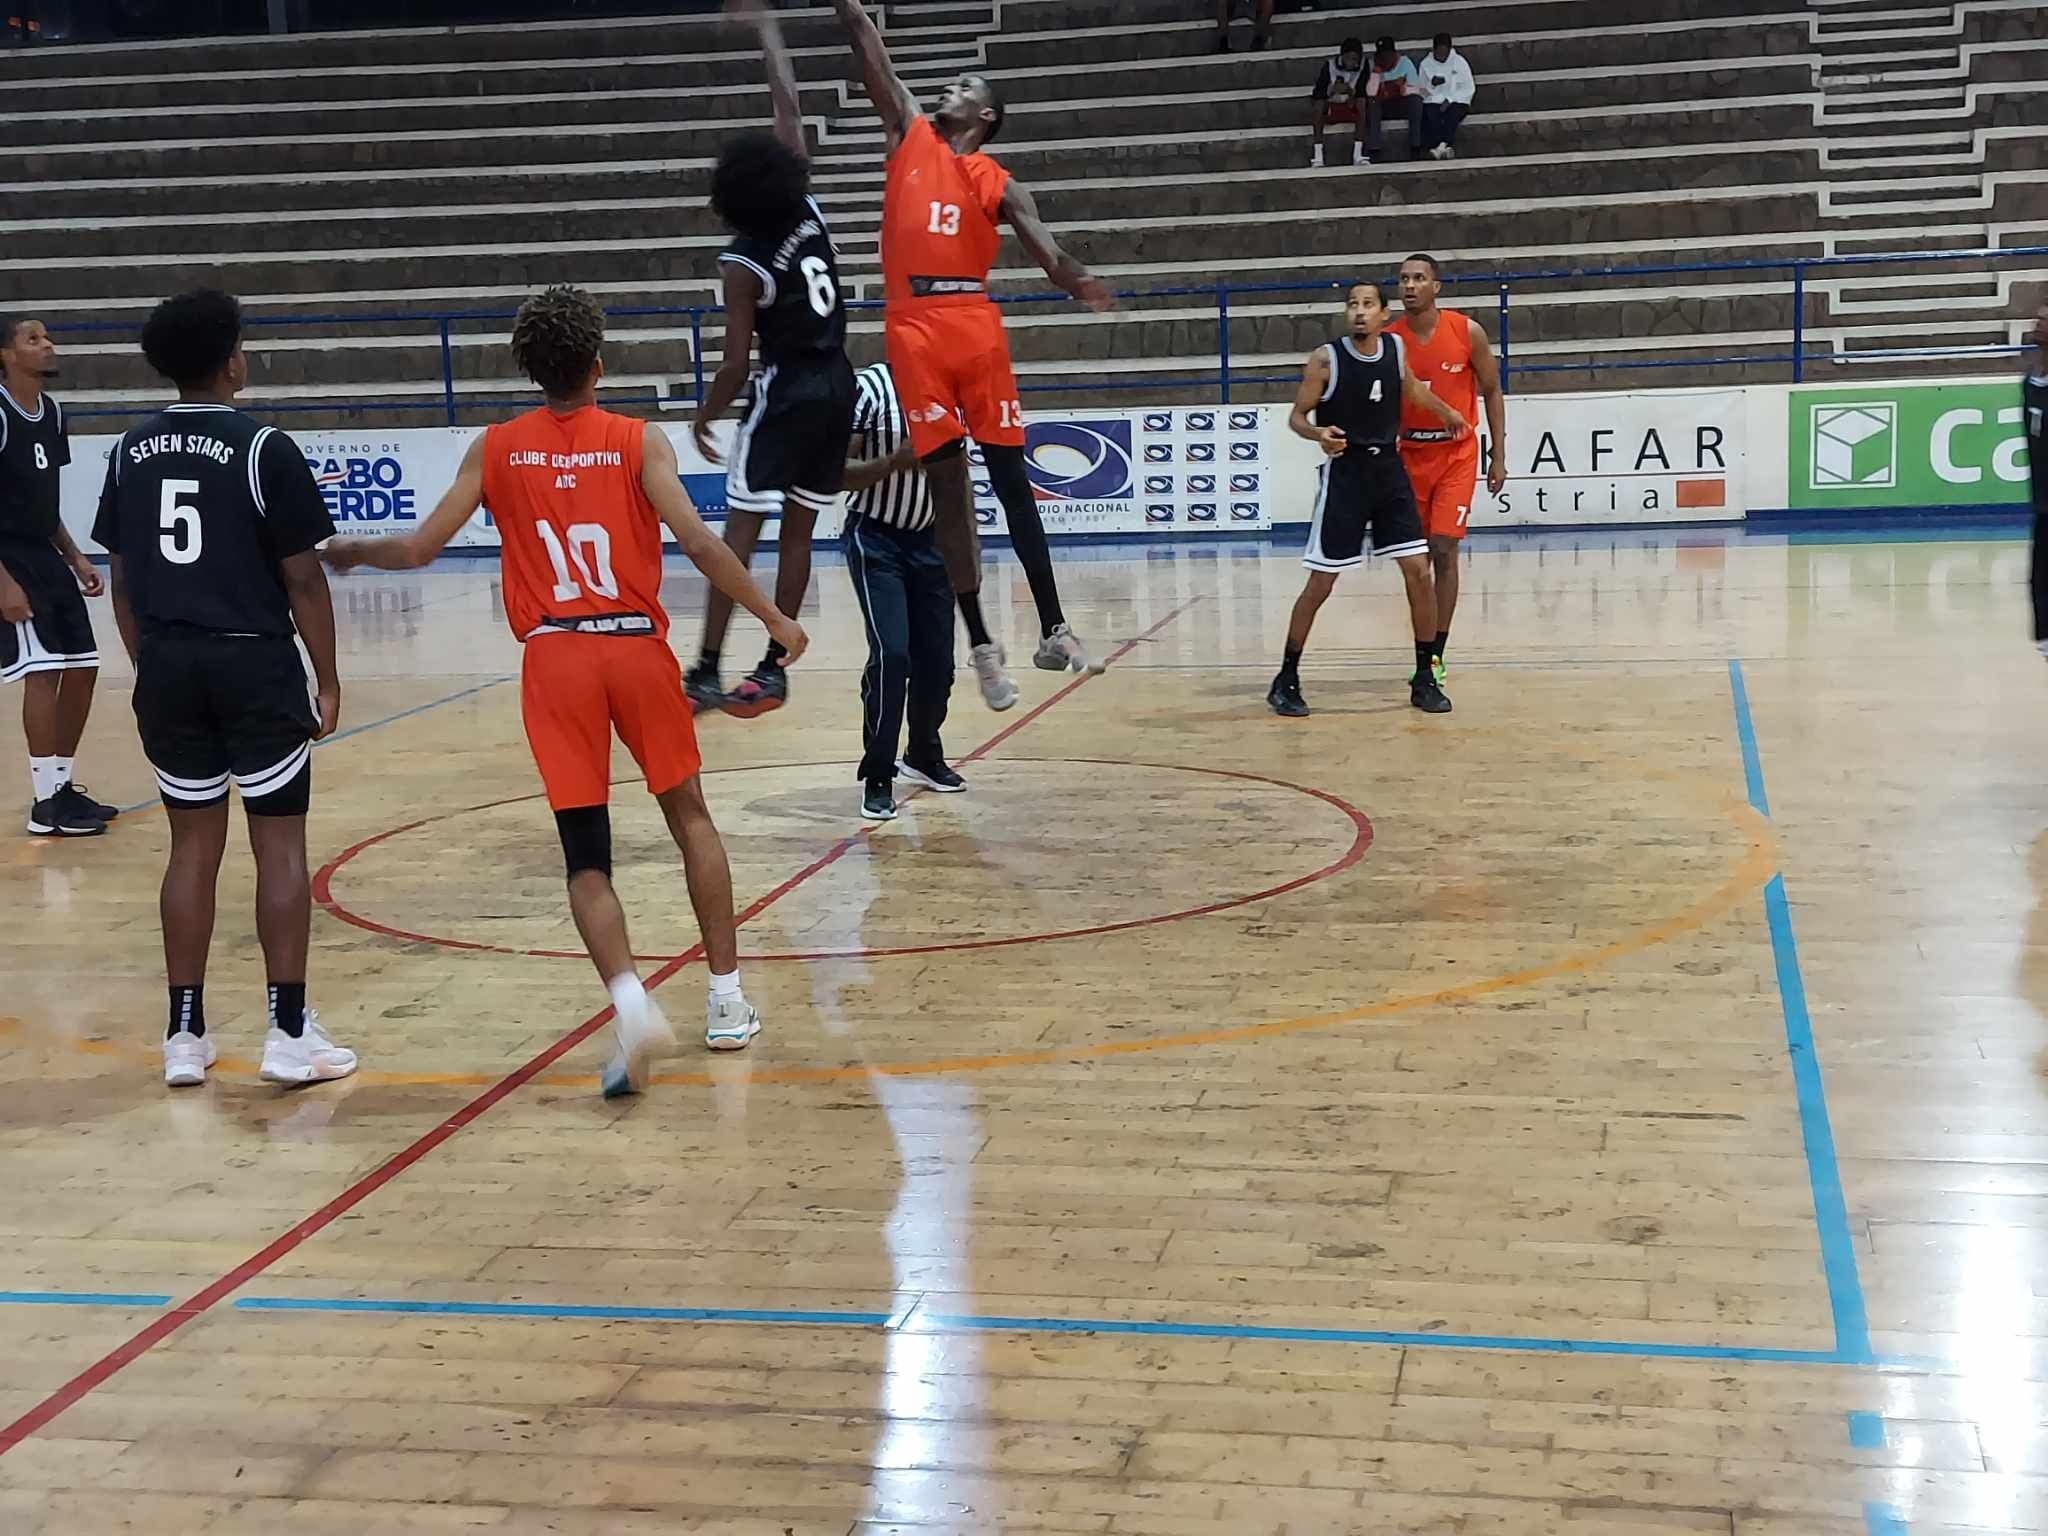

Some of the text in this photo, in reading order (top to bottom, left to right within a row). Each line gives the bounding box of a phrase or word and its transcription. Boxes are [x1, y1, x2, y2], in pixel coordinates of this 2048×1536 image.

[927, 201, 960, 235] 13
[800, 256, 836, 317] 6
[1369, 380, 1383, 402] 4
[34, 442, 48, 469] 8
[129, 434, 234, 464] SEVEN STARS
[305, 443, 400, 454] OVERNO DE
[509, 450, 547, 466] CLUBE
[320, 489, 417, 521] ERDE
[1039, 503, 1131, 514] DIO NACIONAL
[1498, 483, 1660, 514] stria
[160, 478, 203, 565] 5
[1456, 506, 1467, 527] 7
[536, 519, 619, 602] 10
